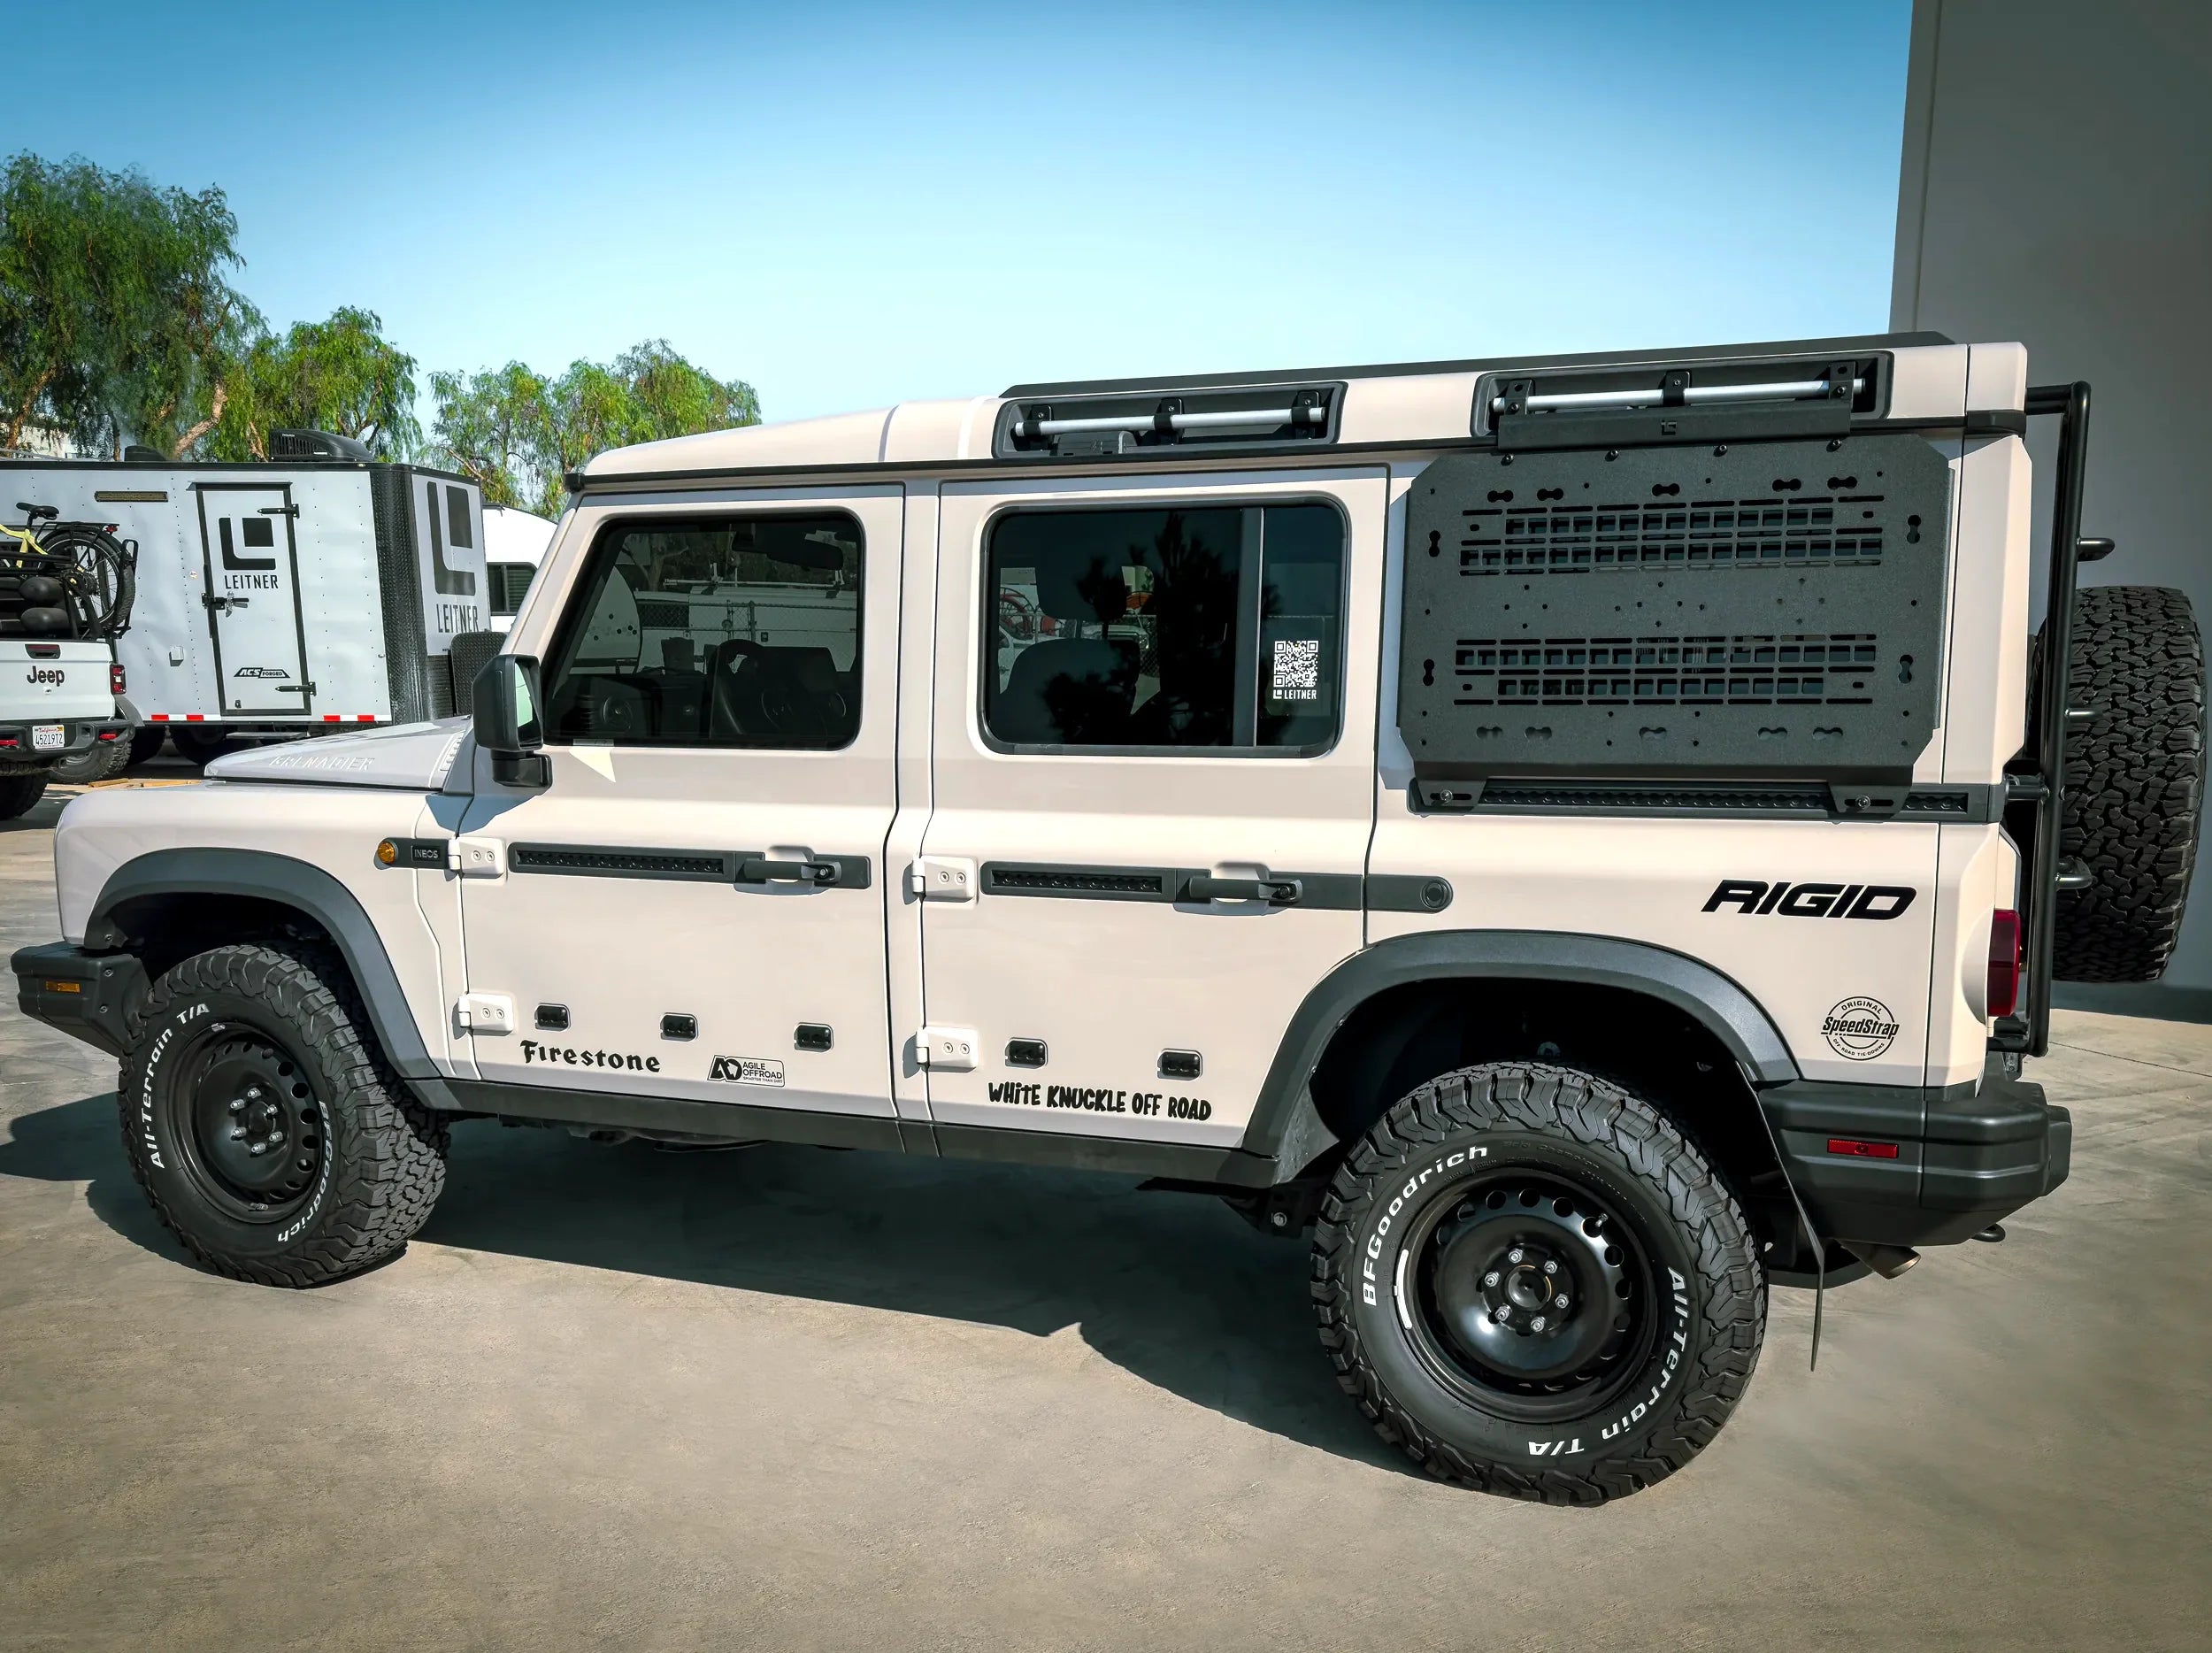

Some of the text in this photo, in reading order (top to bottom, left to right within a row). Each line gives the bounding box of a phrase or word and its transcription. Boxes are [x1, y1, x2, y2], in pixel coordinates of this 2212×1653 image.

[224, 574, 279, 589] LEITNER
[436, 604, 479, 633] LEITNER
[27, 665, 65, 687] Jeep
[1284, 689, 1317, 700] LEITNER
[414, 849, 439, 858] INEOS
[1700, 879, 1917, 921] RIGID
[177, 1003, 210, 1025] T/A
[1841, 1000, 1882, 1015] ORIGINAL
[1822, 1016, 1901, 1040] SpeedStrap
[520, 1039, 661, 1073] Firestone
[742, 1061, 765, 1070] AGILE
[742, 1069, 783, 1080] OFFROAD
[142, 1027, 173, 1169] All-Terrain
[1046, 1085, 1127, 1113] KNUCKLE
[1132, 1092, 1163, 1116] OFF
[1167, 1096, 1212, 1121] ROAD
[277, 1100, 333, 1243] BFGoodrich
[1363, 1146, 1487, 1307] BFGoodrich
[1601, 1266, 1697, 1440] All-Terrain
[1528, 1438, 1585, 1457] T/A
